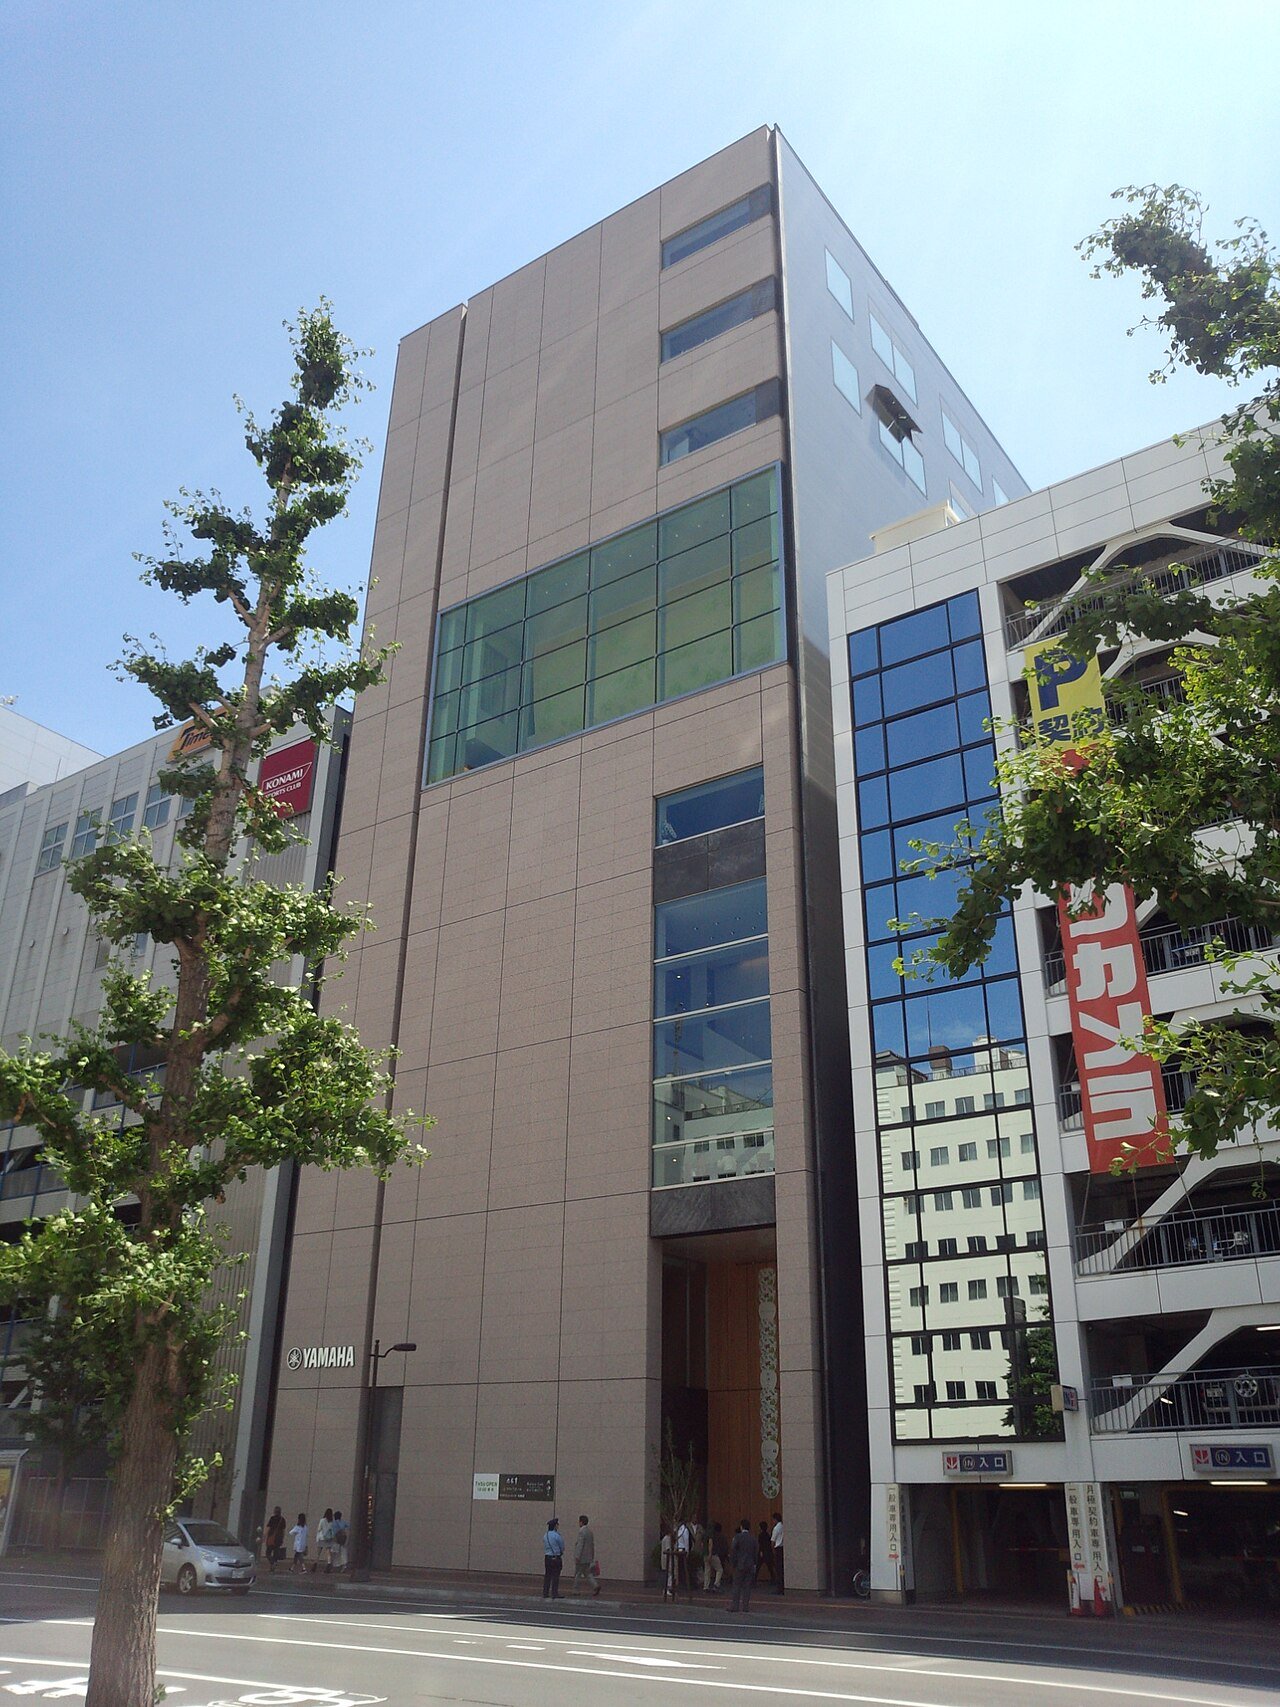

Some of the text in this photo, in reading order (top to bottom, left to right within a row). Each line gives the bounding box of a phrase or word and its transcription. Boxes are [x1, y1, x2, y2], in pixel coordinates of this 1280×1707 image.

[1034, 650, 1088, 711] P
[266, 768, 304, 790] KONAMI
[286, 782, 302, 792] CLUB
[303, 1346, 354, 1369] YAMAHA
[979, 1457, 1004, 1468] 入口
[1235, 1451, 1266, 1464] 入口
[1068, 1487, 1082, 1561] 一般車専用入口
